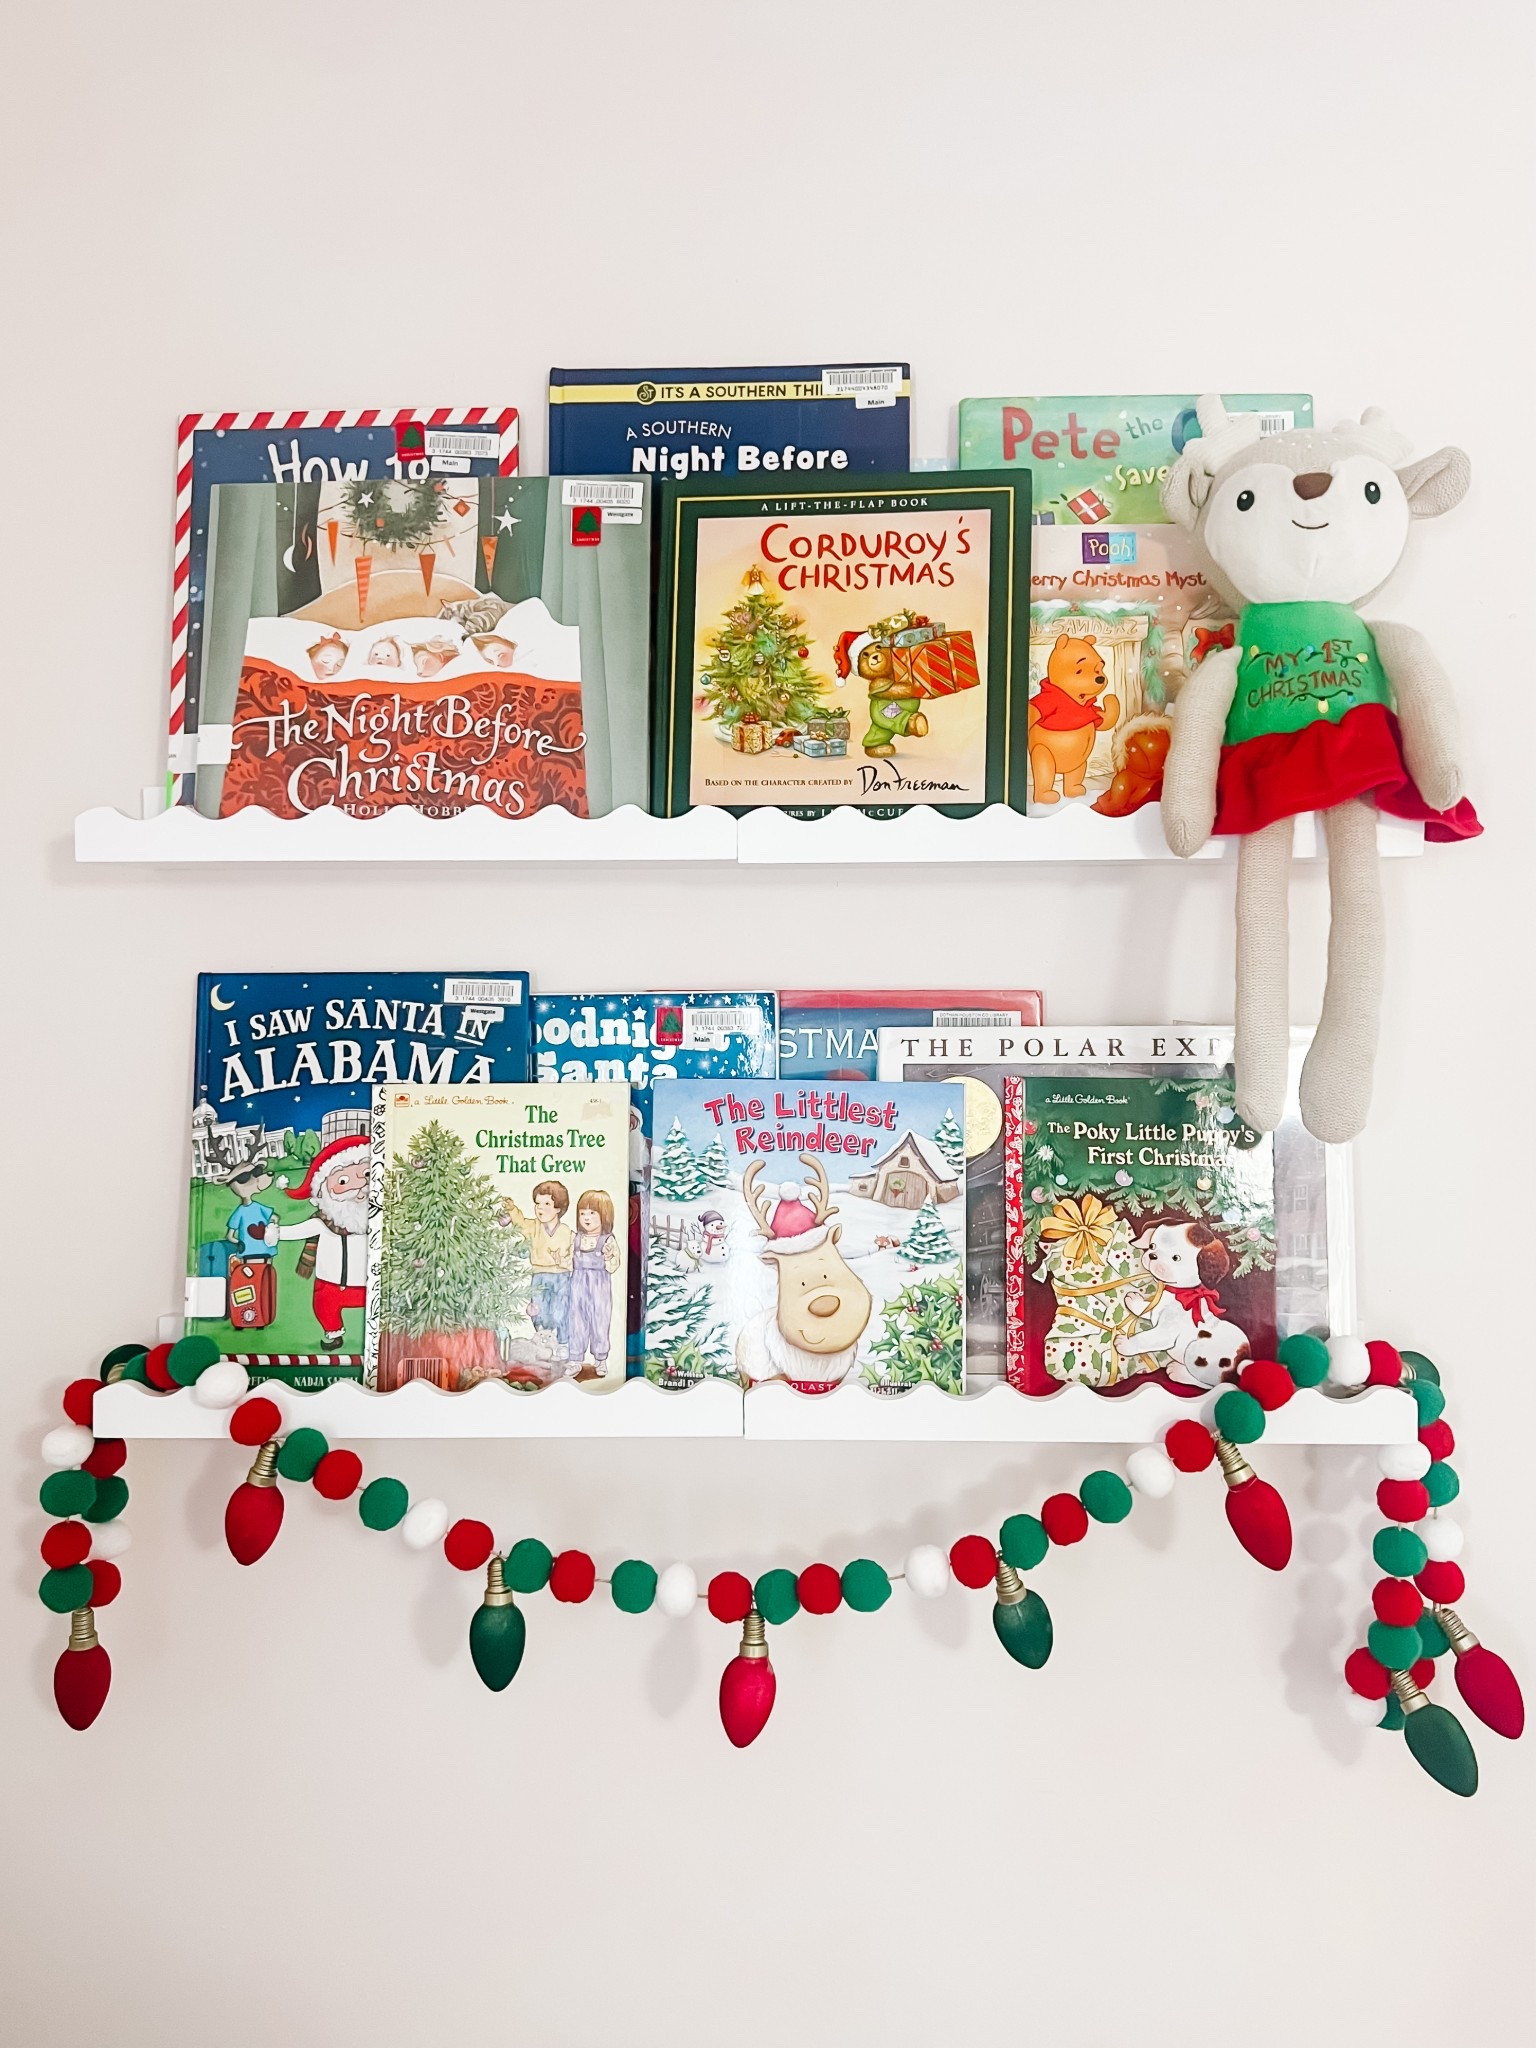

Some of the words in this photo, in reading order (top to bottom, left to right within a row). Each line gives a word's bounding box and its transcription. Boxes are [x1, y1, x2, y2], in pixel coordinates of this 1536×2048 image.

[661, 387, 691, 399] IT'S
[693, 387, 704, 398] A
[709, 384, 787, 398] SOUTHERN
[626, 427, 638, 441] A
[642, 420, 732, 440] SOUTHERN
[1002, 406, 1120, 460] Pete
[1125, 416, 1163, 439] the
[267, 438, 369, 483] How
[632, 446, 725, 480] Night
[738, 446, 849, 472] Before
[1115, 463, 1170, 491] Save
[761, 503, 769, 511] A
[775, 499, 885, 510] LIFT-THE-FLAP
[891, 497, 929, 507] BOOK
[760, 515, 971, 563] CORDUROY'S
[1088, 539, 1132, 558] Pooh
[778, 561, 955, 592] CHRISTMAS
[1031, 576, 1067, 589] erry
[1072, 571, 1161, 588] Christmas
[1165, 571, 1207, 588] Myst
[1265, 653, 1299, 675] MY
[1247, 670, 1363, 708] CHRISTMAS
[229, 698, 330, 757] The
[326, 693, 433, 762] Night
[433, 695, 588, 766] Before
[287, 743, 527, 815] Christmas
[705, 778, 728, 786] BASED
[730, 778, 742, 786] ON
[744, 778, 758, 786] THE
[760, 777, 806, 786] CHARACTER
[808, 777, 841, 786] CREATED
[844, 777, 853, 786] BY
[857, 765, 893, 796] Don
[883, 759, 970, 791] Freeman
[223, 1020, 240, 1046] I
[249, 1007, 314, 1039] SAW
[324, 998, 446, 1037] SANTA
[455, 1010, 491, 1040] IN
[901, 1038, 973, 1056] THE
[999, 1038, 1126, 1056] POLAR
[219, 1039, 495, 1102] ALABAMA
[424, 1095, 447, 1105] Little
[452, 1095, 483, 1105] Golden
[485, 1096, 509, 1105] Book
[703, 1093, 765, 1125] The
[773, 1090, 897, 1130] Littlest
[1052, 1094, 1074, 1104] Little
[1074, 1094, 1105, 1104] Golden
[1107, 1094, 1129, 1104] Book
[525, 1105, 558, 1123] The
[475, 1130, 564, 1148] Christmas
[566, 1130, 606, 1147] Tree
[735, 1122, 877, 1155] Reindeer
[1047, 1121, 1071, 1133] The
[1073, 1121, 1121, 1142] Poky
[1125, 1122, 1177, 1140] Little
[1182, 1124, 1255, 1145] Puppy's
[496, 1155, 536, 1173] That
[541, 1154, 586, 1173] Grew
[1088, 1147, 1133, 1164] First
[1138, 1147, 1230, 1166] Christma
[294, 1376, 324, 1386] NADJA
